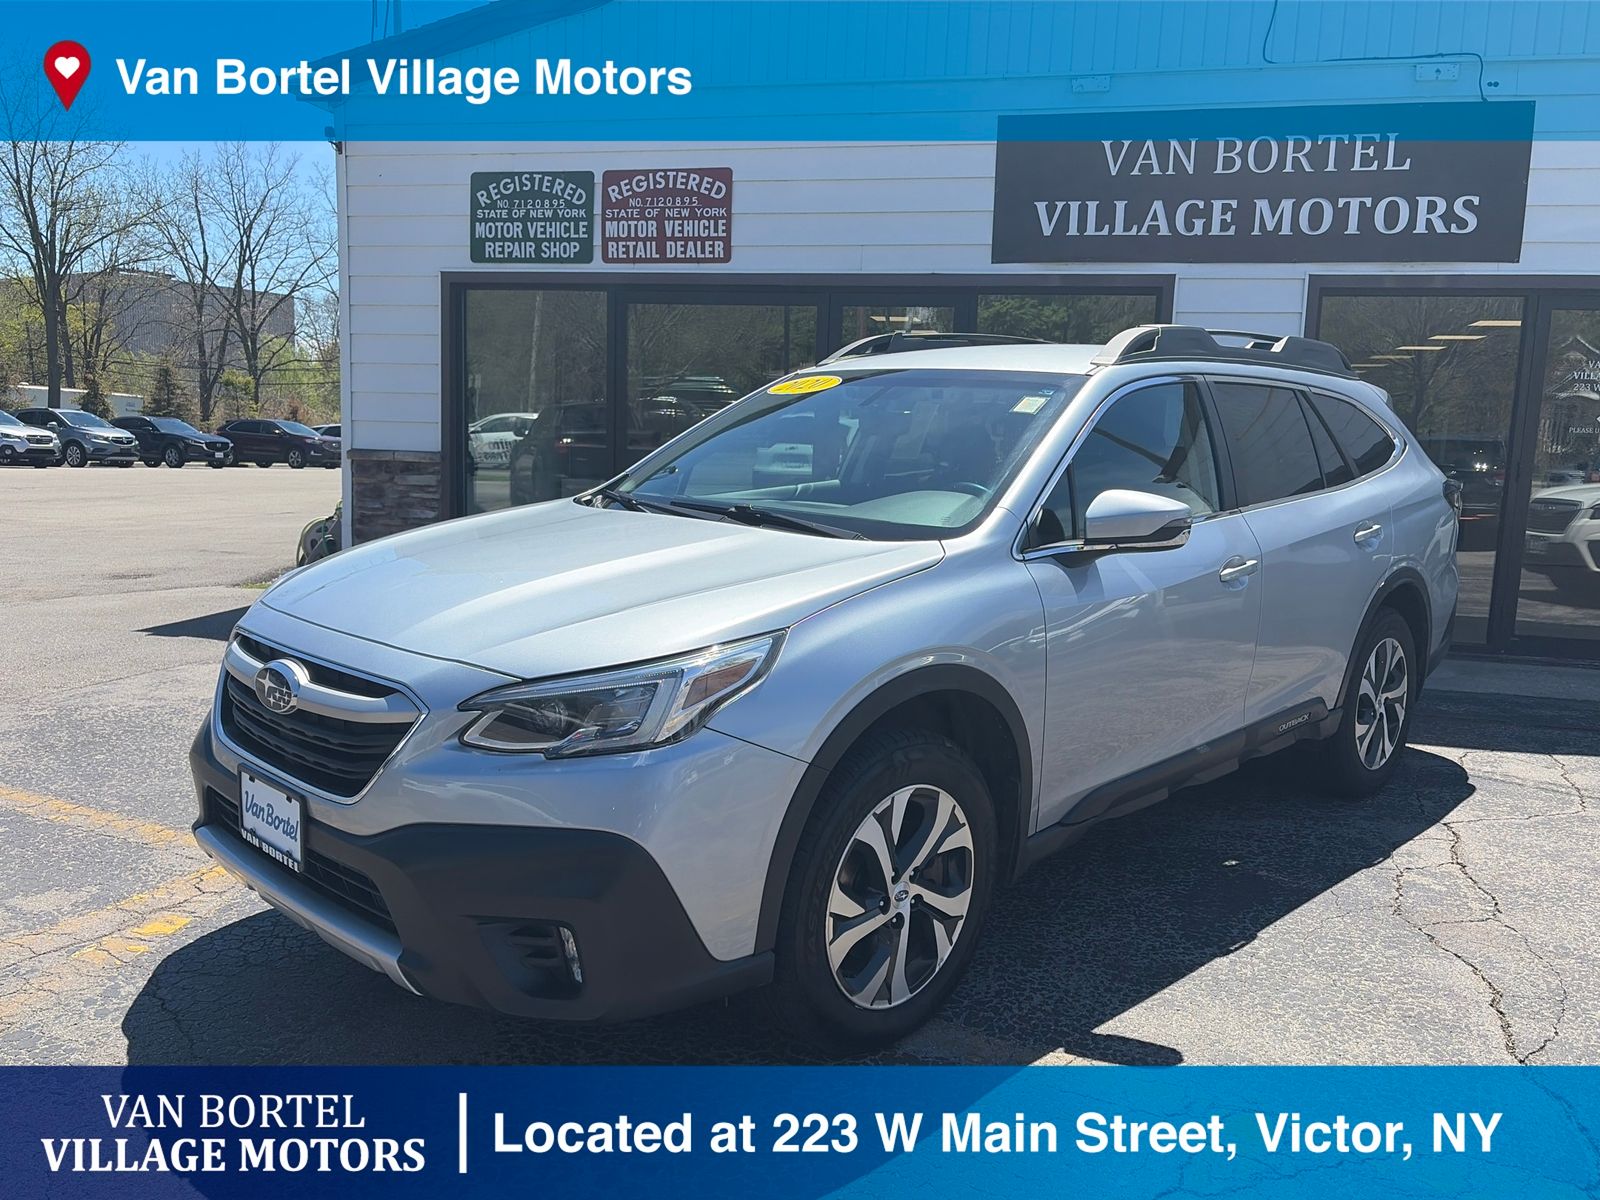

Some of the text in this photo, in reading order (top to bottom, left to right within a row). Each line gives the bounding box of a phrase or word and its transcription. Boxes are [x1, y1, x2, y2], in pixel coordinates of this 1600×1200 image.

[1101, 132, 1412, 176] VAN BORTEL
[476, 174, 587, 207] REGISTERED
[607, 171, 727, 202] REGISTERED
[513, 199, 566, 209] 7120895
[645, 197, 699, 207] 7120895
[476, 209, 586, 218] STATE OF NEW YORK
[605, 207, 727, 217] STATE OF NEW YORK
[1034, 195, 1481, 237] VILLAGE MOTORS
[475, 222, 588, 238] MOTOR VEHICLE
[605, 220, 726, 238] MOTOR VEHICLE
[485, 242, 580, 258] REPAIR SHOP
[608, 241, 724, 259] RETAIL DEALER
[1573, 383, 1591, 391] 223
[1569, 426, 1594, 434] PLEASE
[241, 828, 299, 873] VAN BORTEL
